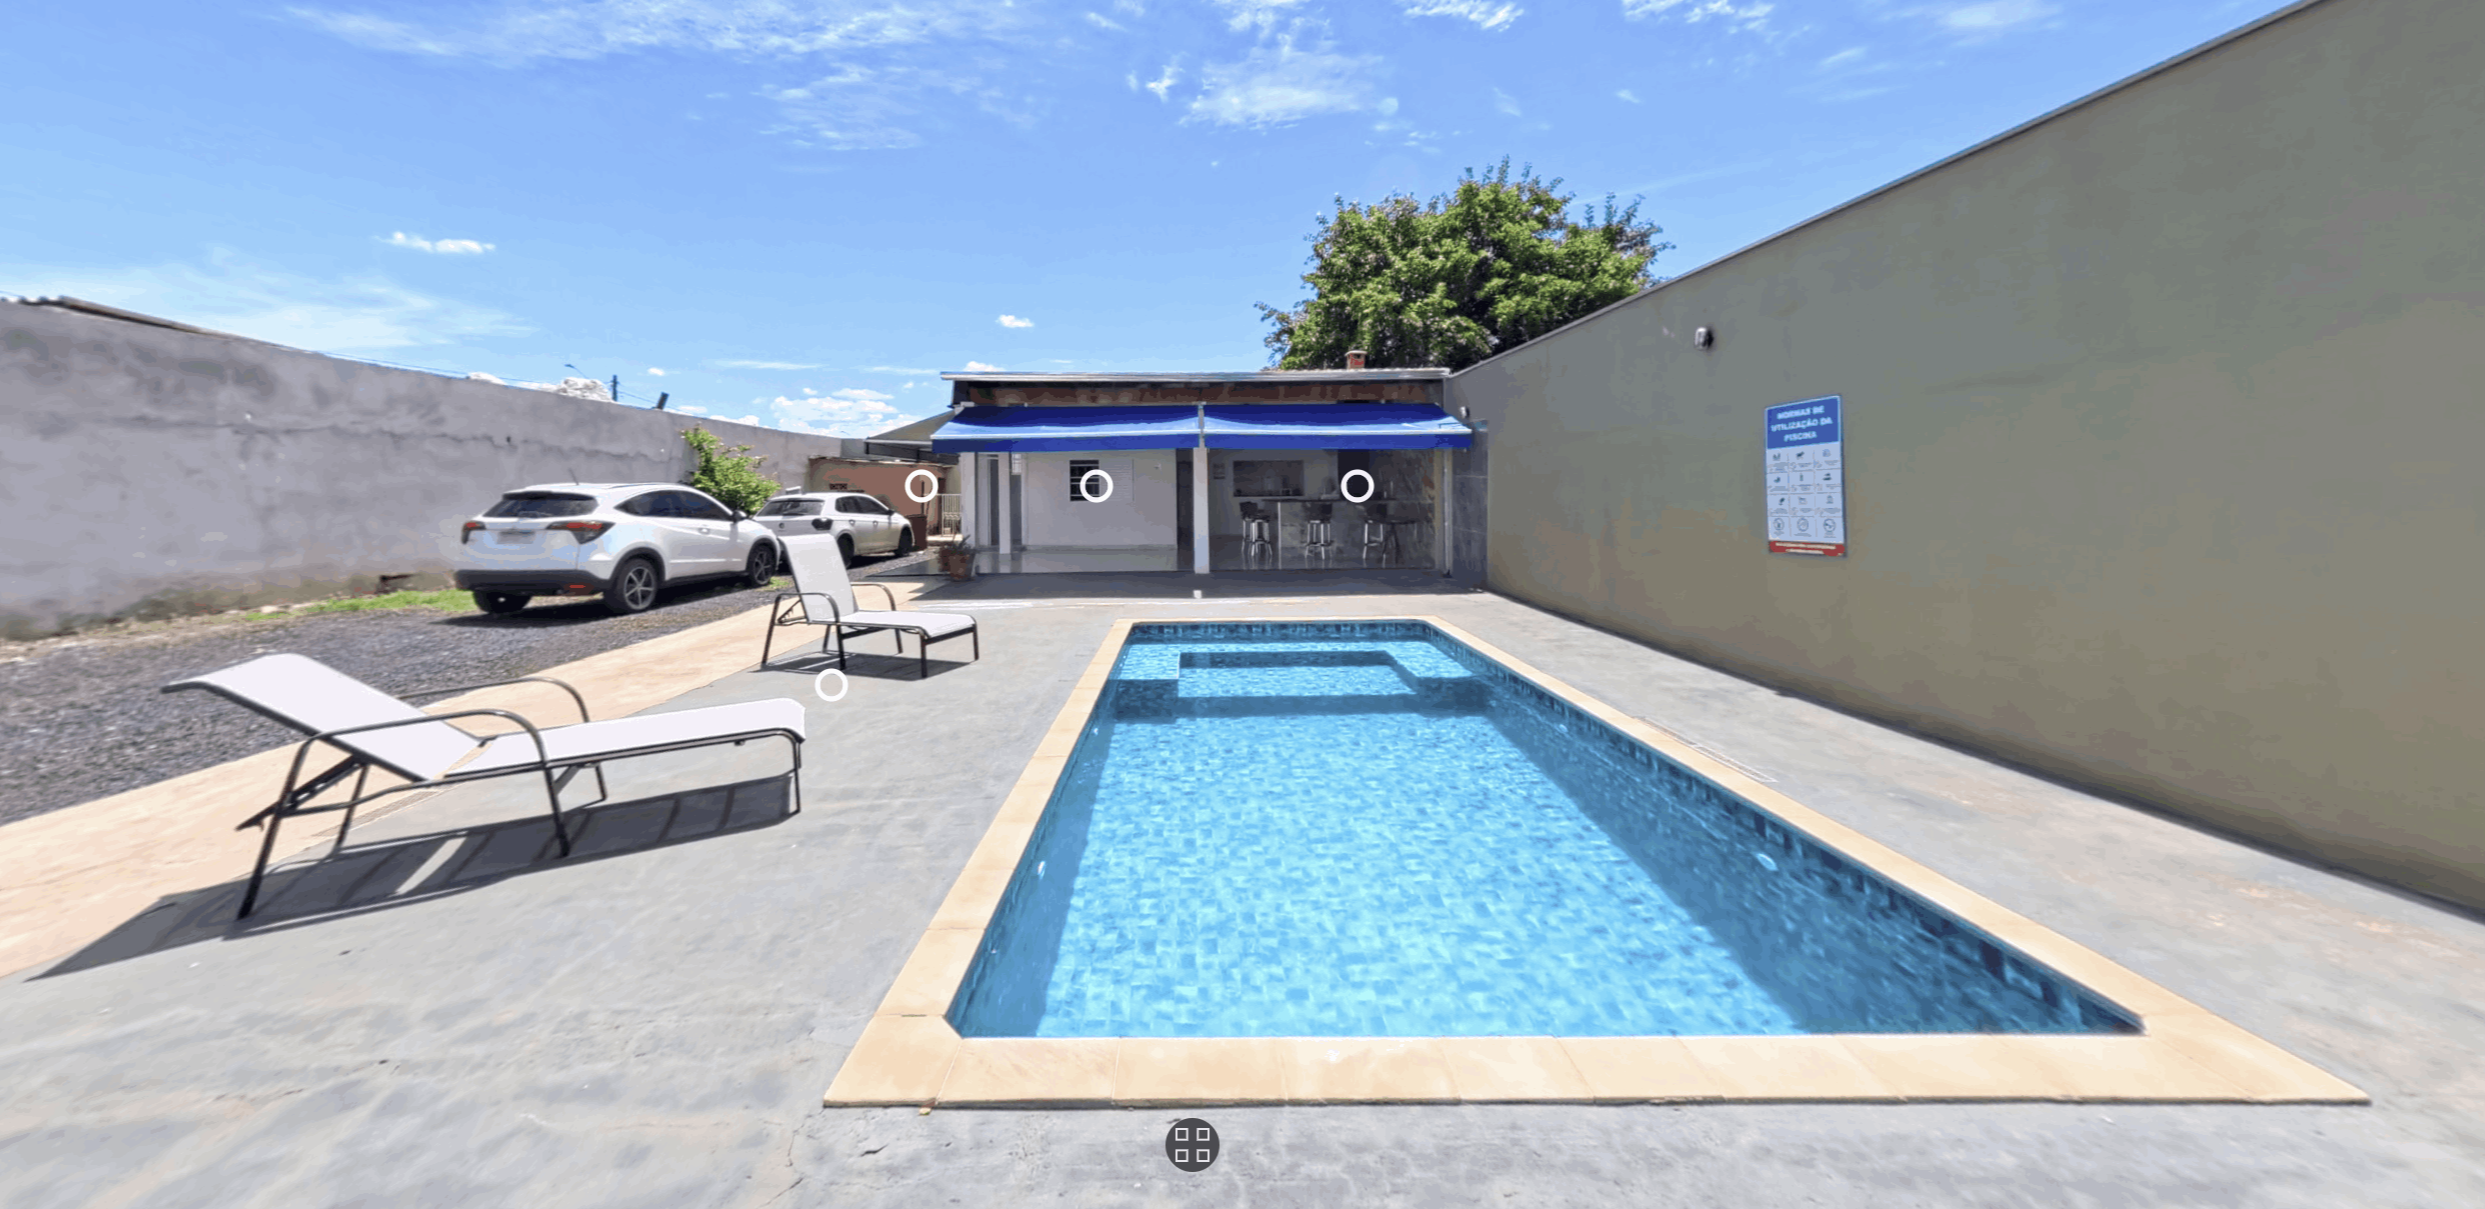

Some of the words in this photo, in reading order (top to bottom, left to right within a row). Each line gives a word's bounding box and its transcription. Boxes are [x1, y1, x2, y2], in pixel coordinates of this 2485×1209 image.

[1777, 407, 1811, 419] NORMAS
[1812, 405, 1825, 415] DE
[1771, 418, 1818, 432] UTILIZAÇÃO
[1820, 416, 1833, 426] DA
[1783, 431, 1817, 442] PISCINA
